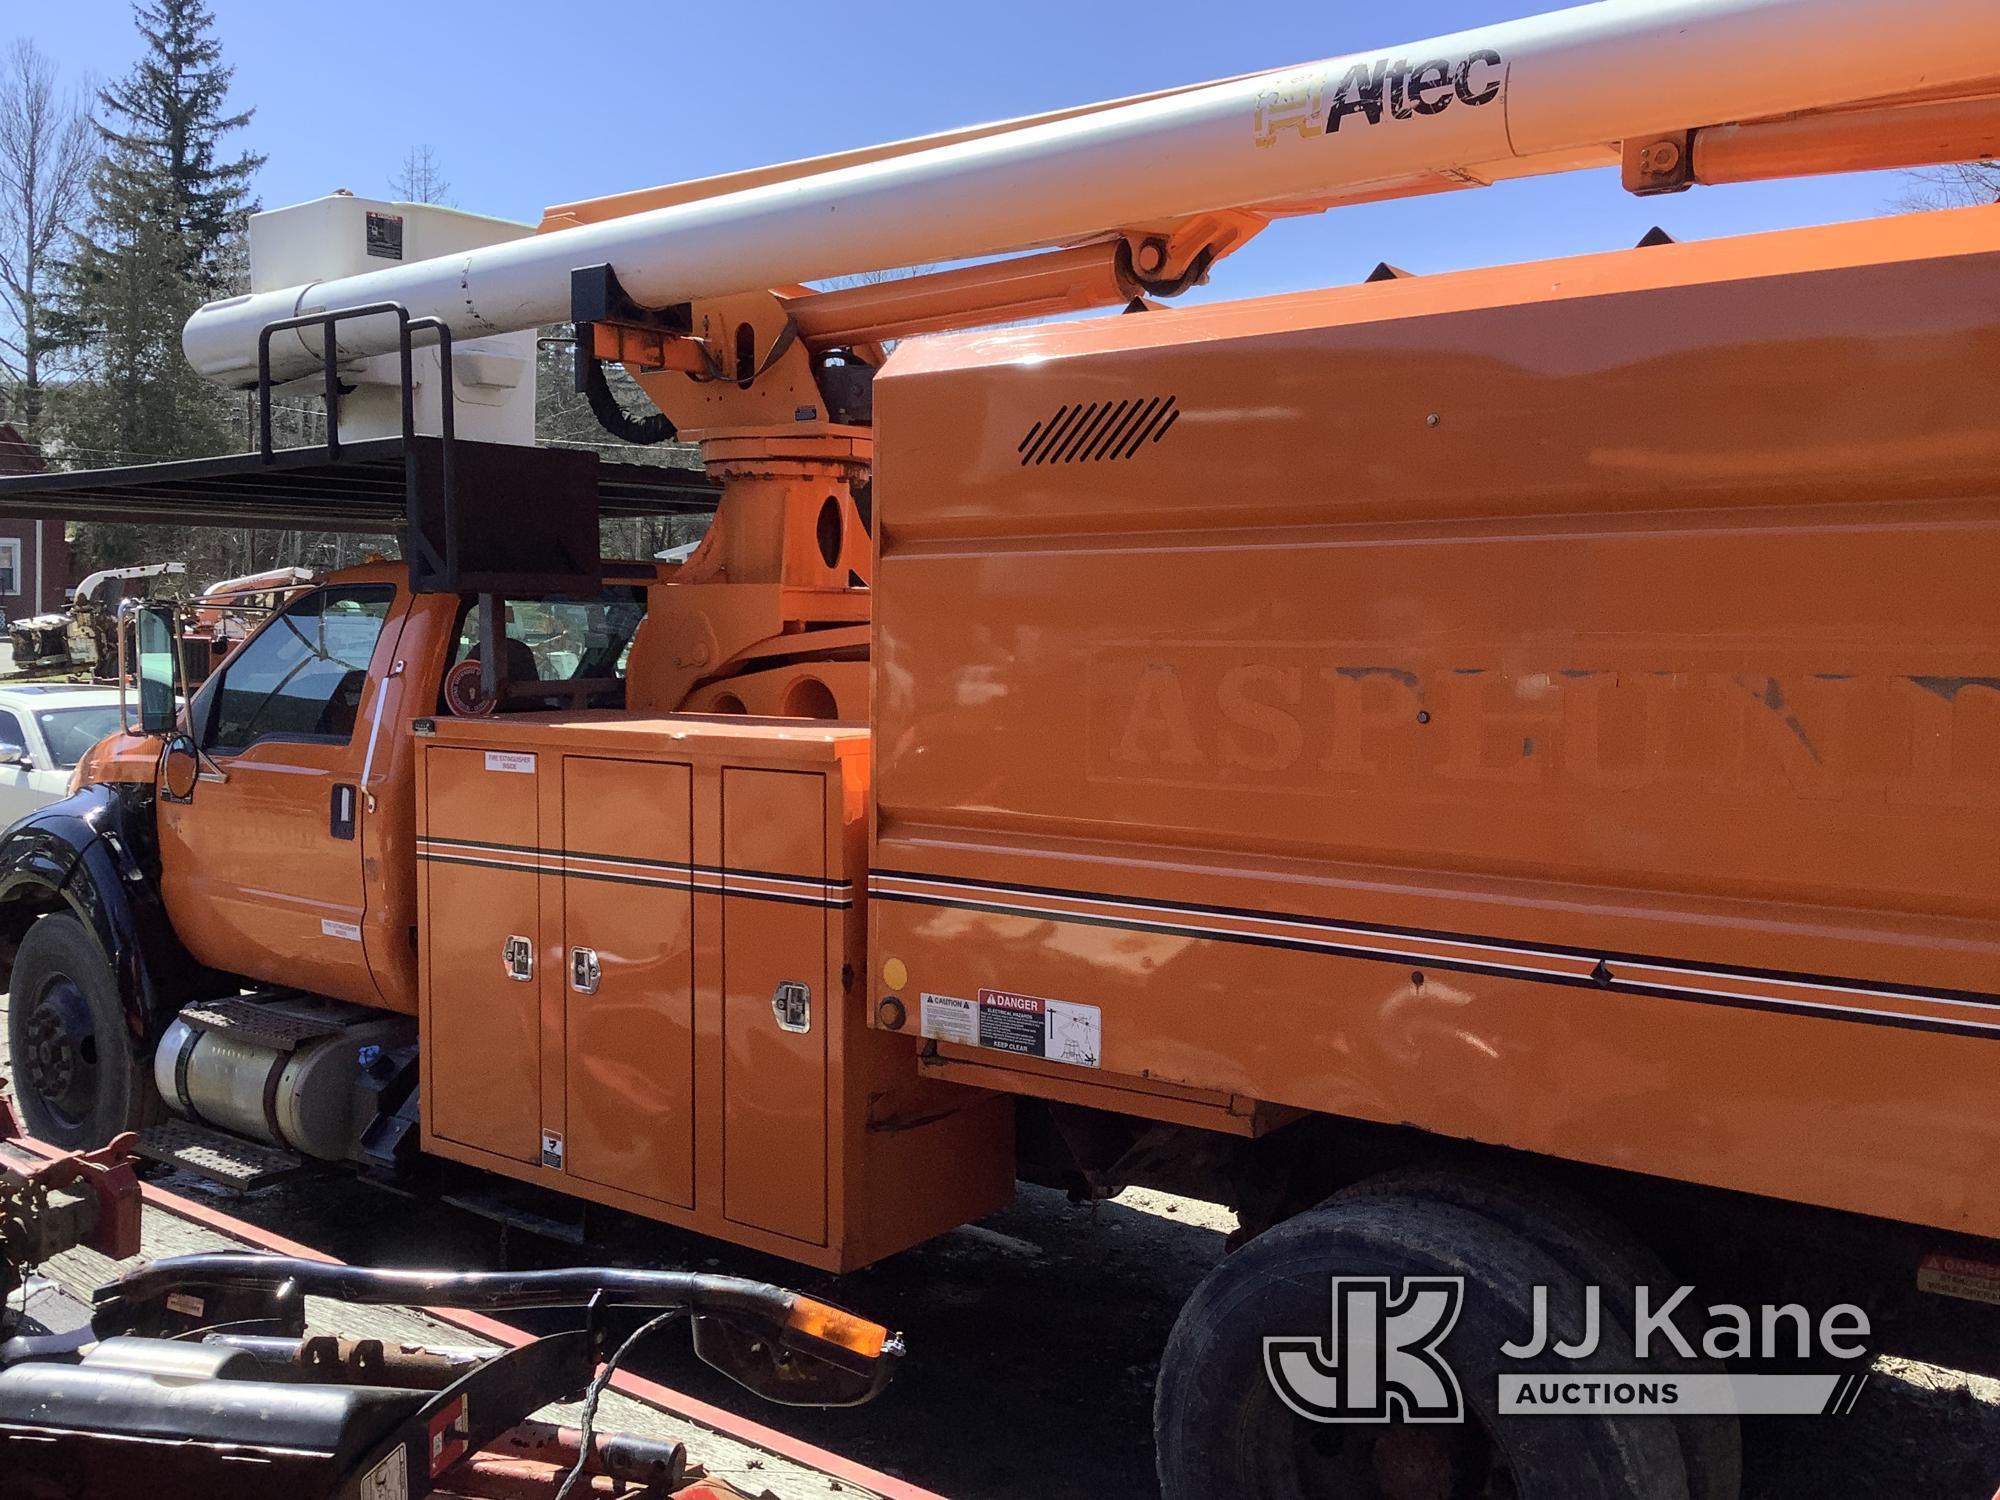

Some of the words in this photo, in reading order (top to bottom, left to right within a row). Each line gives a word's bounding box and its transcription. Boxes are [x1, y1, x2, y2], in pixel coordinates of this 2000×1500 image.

[1325, 49, 1502, 134] Altec
[934, 997, 962, 1008] CAUTION
[997, 995, 1038, 1011] DANGER
[993, 1041, 1009, 1049] KEEP
[1009, 1043, 1028, 1052] CLEAR
